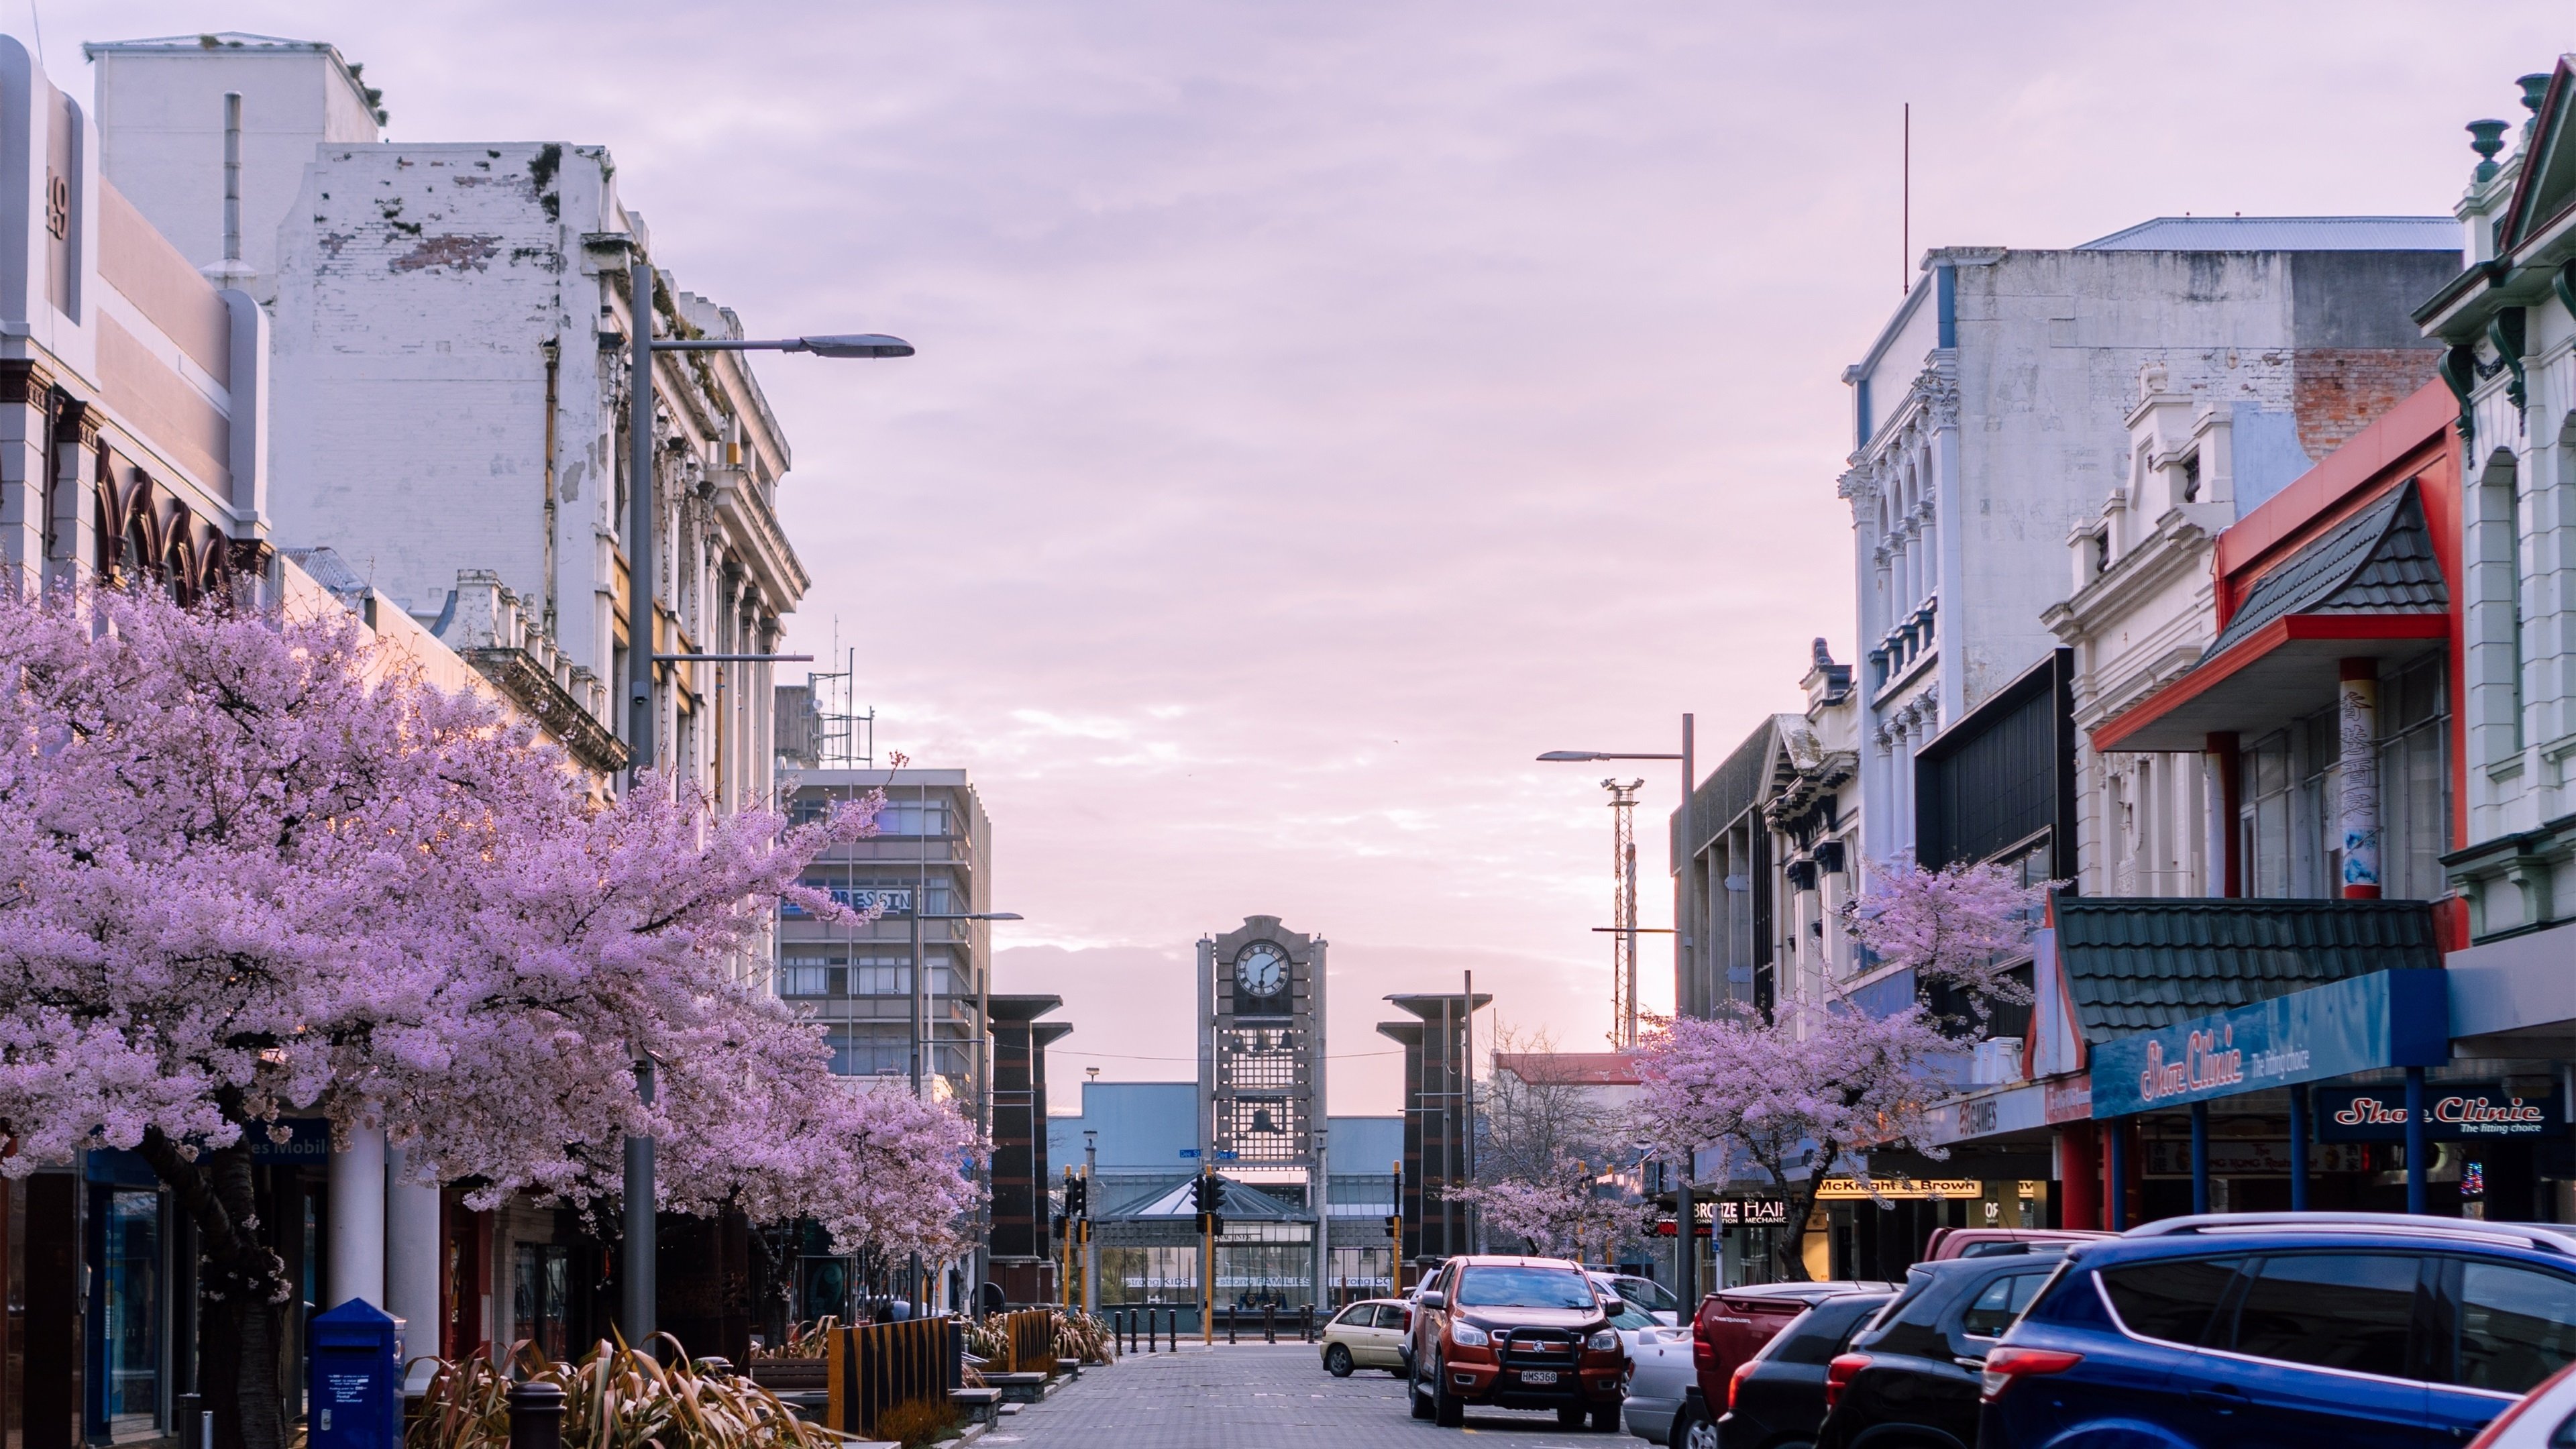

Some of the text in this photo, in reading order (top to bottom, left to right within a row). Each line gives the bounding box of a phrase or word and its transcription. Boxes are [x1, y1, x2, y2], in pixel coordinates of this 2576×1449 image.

[2141, 1024, 2309, 1102] Shoe Clinic The fitting choice
[2434, 1097, 2544, 1122] Clinic
[1970, 1100, 1996, 1135] GAMES
[2461, 1123, 2542, 1134] The fitting choice
[2252, 1143, 2270, 1155] The
[1921, 1180, 1976, 1190] Brown
[1694, 1203, 1737, 1218] BROZE
[1126, 1278, 1159, 1287] strong
[1220, 1277, 1311, 1287] strong FAMILIES
[1338, 1278, 1371, 1286] srong
[1523, 1372, 1556, 1382] HMS368
